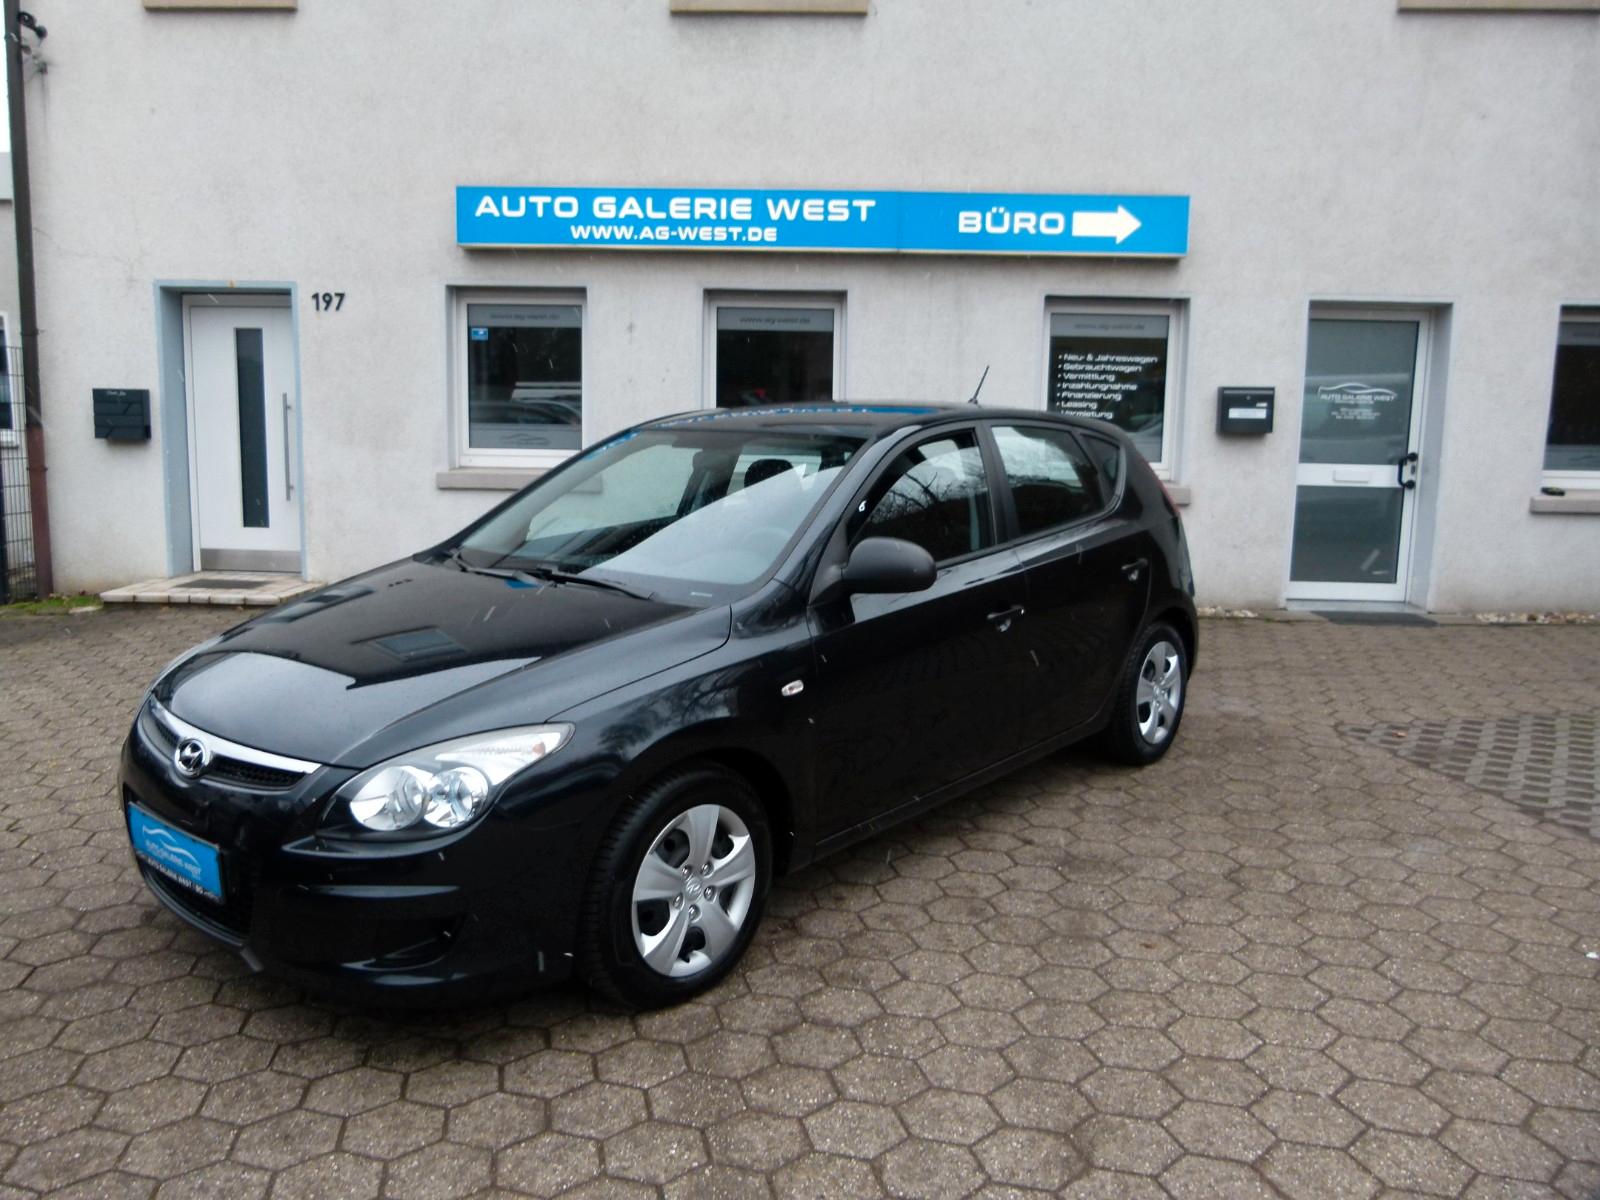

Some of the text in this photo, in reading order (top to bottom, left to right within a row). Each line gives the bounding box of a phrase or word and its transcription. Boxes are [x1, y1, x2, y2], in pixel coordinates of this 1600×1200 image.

[475, 195, 877, 222] AUTO GALERIE WEST
[958, 206, 1065, 235] BÜRO
[570, 224, 778, 243] WWW.AG-WEST.DE
[312, 292, 346, 311] 197
[1086, 353, 1094, 362] &
[1094, 354, 1158, 364] Jahreswagen
[1063, 363, 1142, 373] Gebrauchtwagen
[1062, 372, 1116, 382] Vermittlung
[1061, 382, 1138, 392] Inzahlungnahme
[1061, 391, 1122, 402] Finanzierung
[1061, 401, 1098, 410] Leasing
